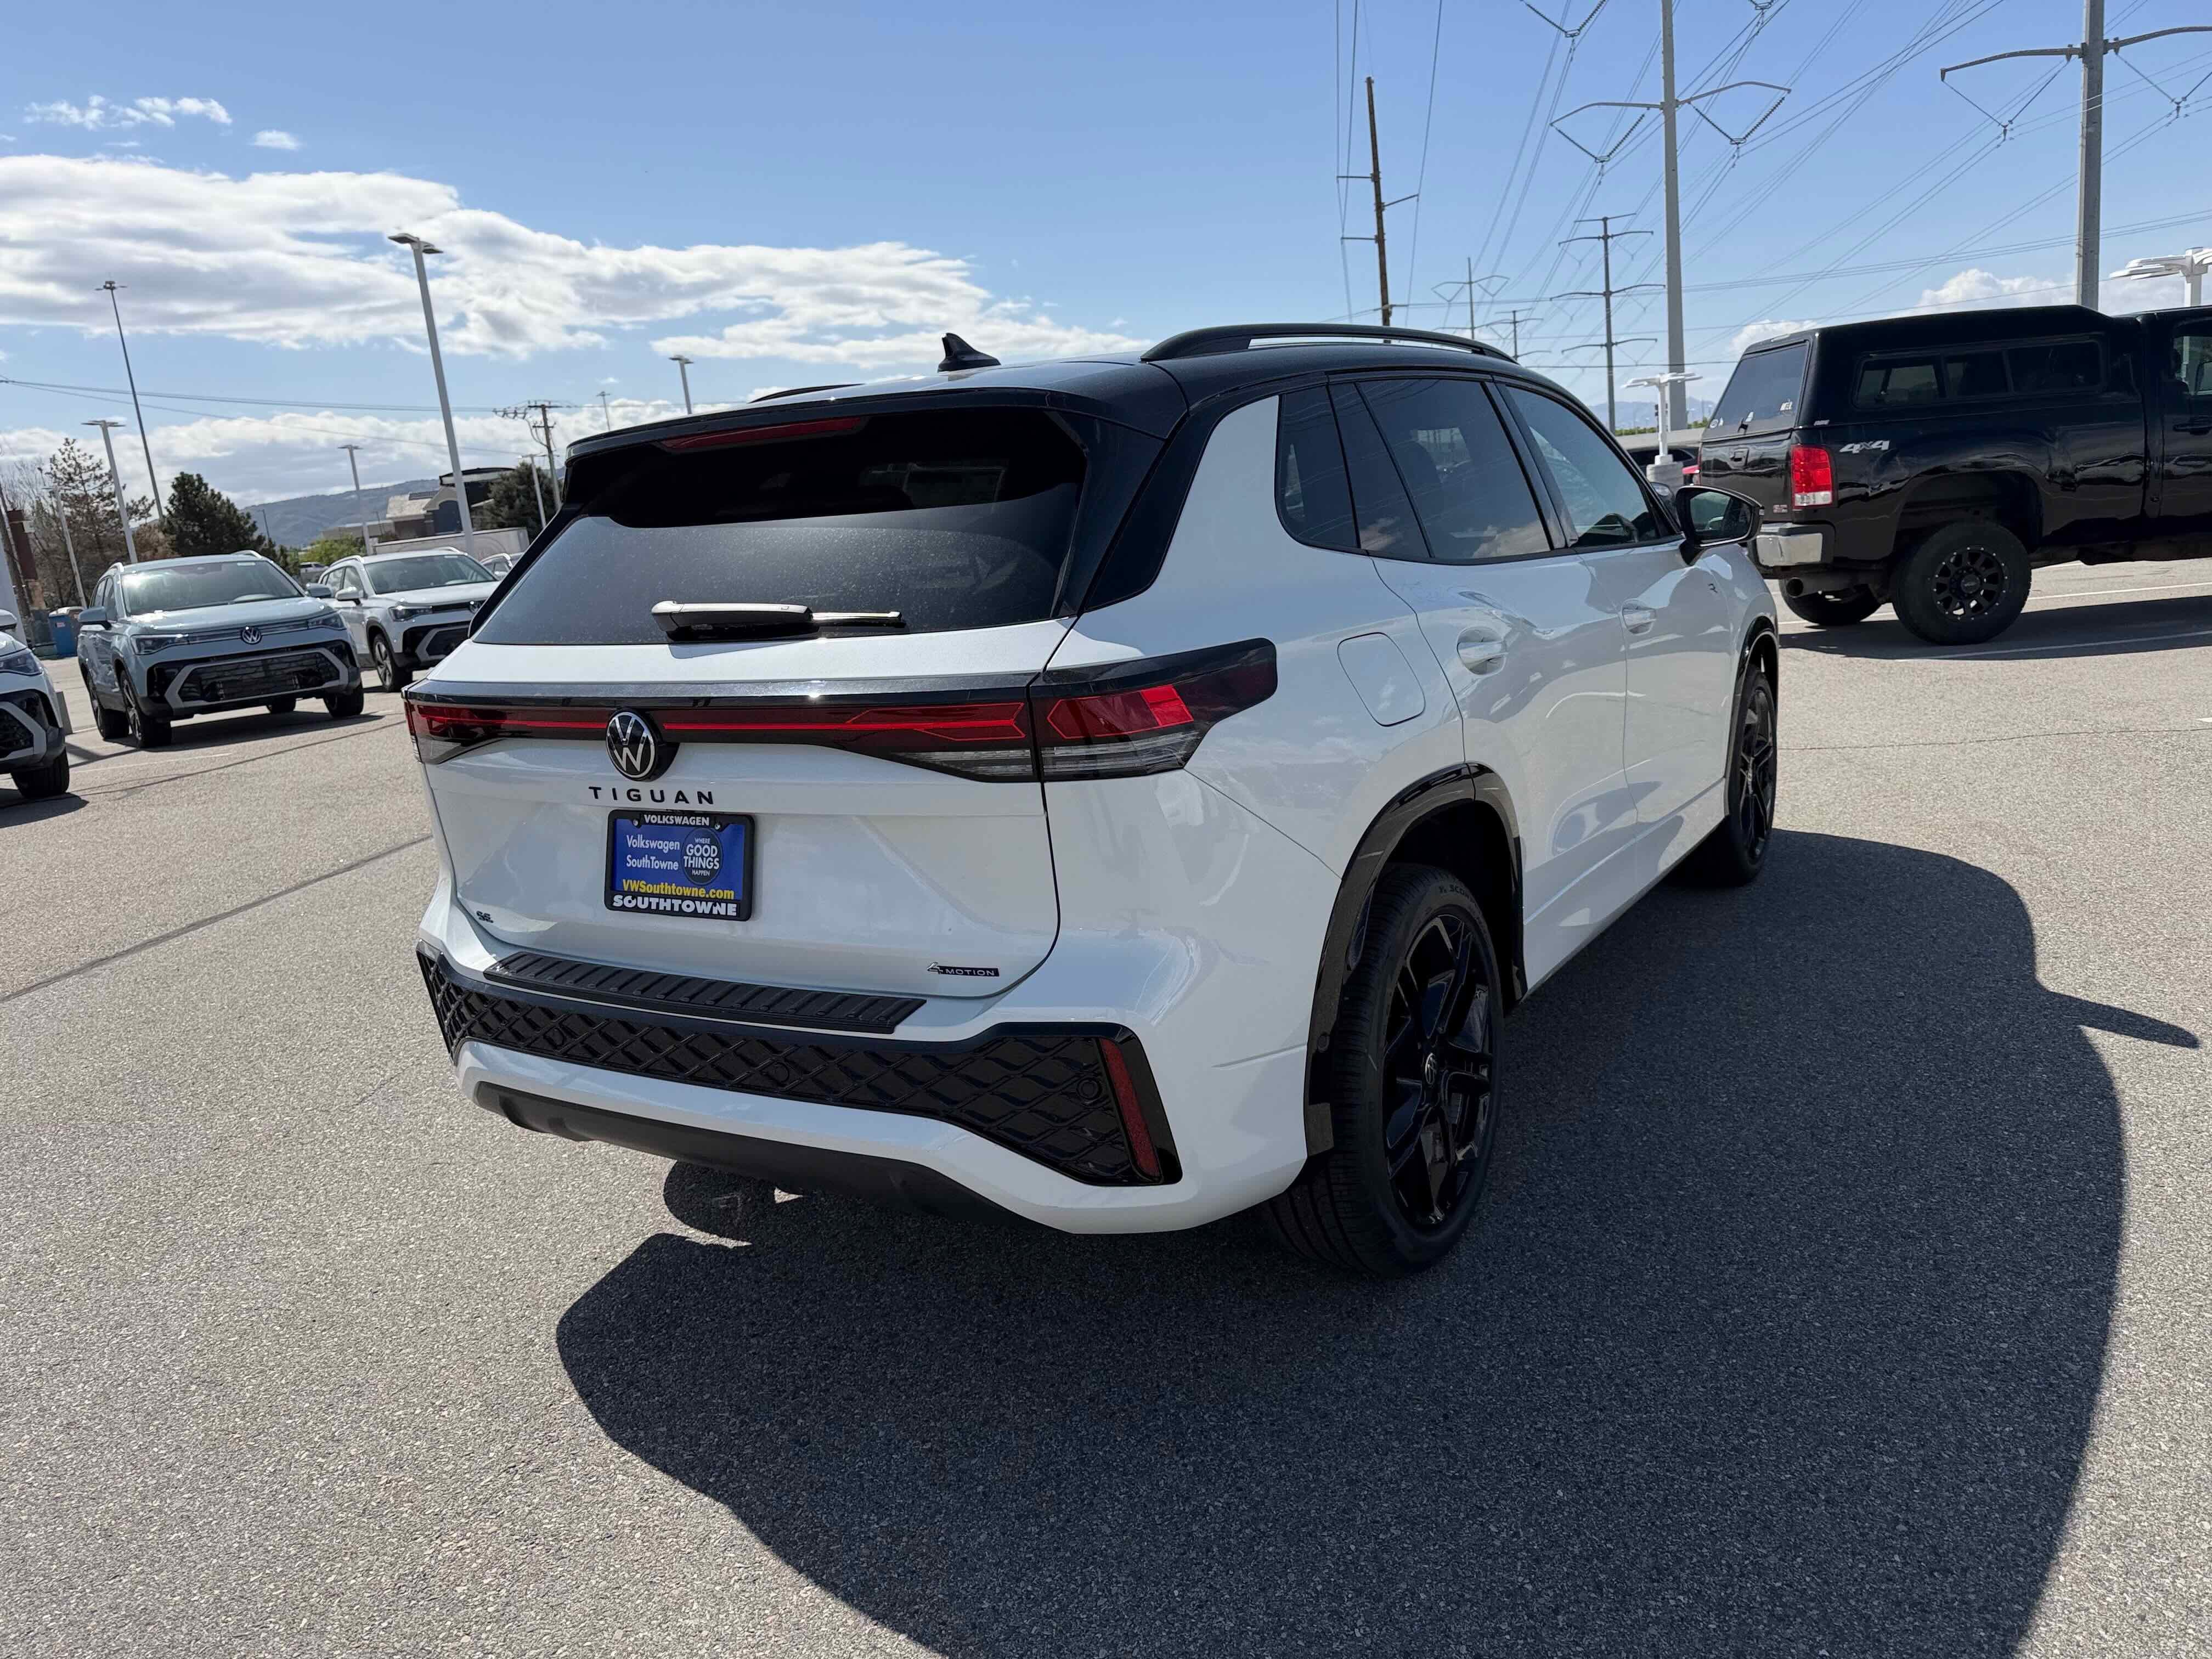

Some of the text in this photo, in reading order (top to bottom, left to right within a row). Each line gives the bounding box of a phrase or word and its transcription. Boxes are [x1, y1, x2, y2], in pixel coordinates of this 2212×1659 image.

[606, 712, 655, 778] VW
[589, 786, 713, 804] TIGUAN
[644, 815, 709, 826] VOLKSWAGEN
[627, 835, 680, 853] Volkswagen
[686, 844, 718, 857] GOOD
[626, 855, 679, 870] SouthTowne
[684, 856, 719, 869] THINGS
[623, 879, 734, 899] VWSouthtowne.com
[613, 895, 737, 916] SOUTHTOWNE
